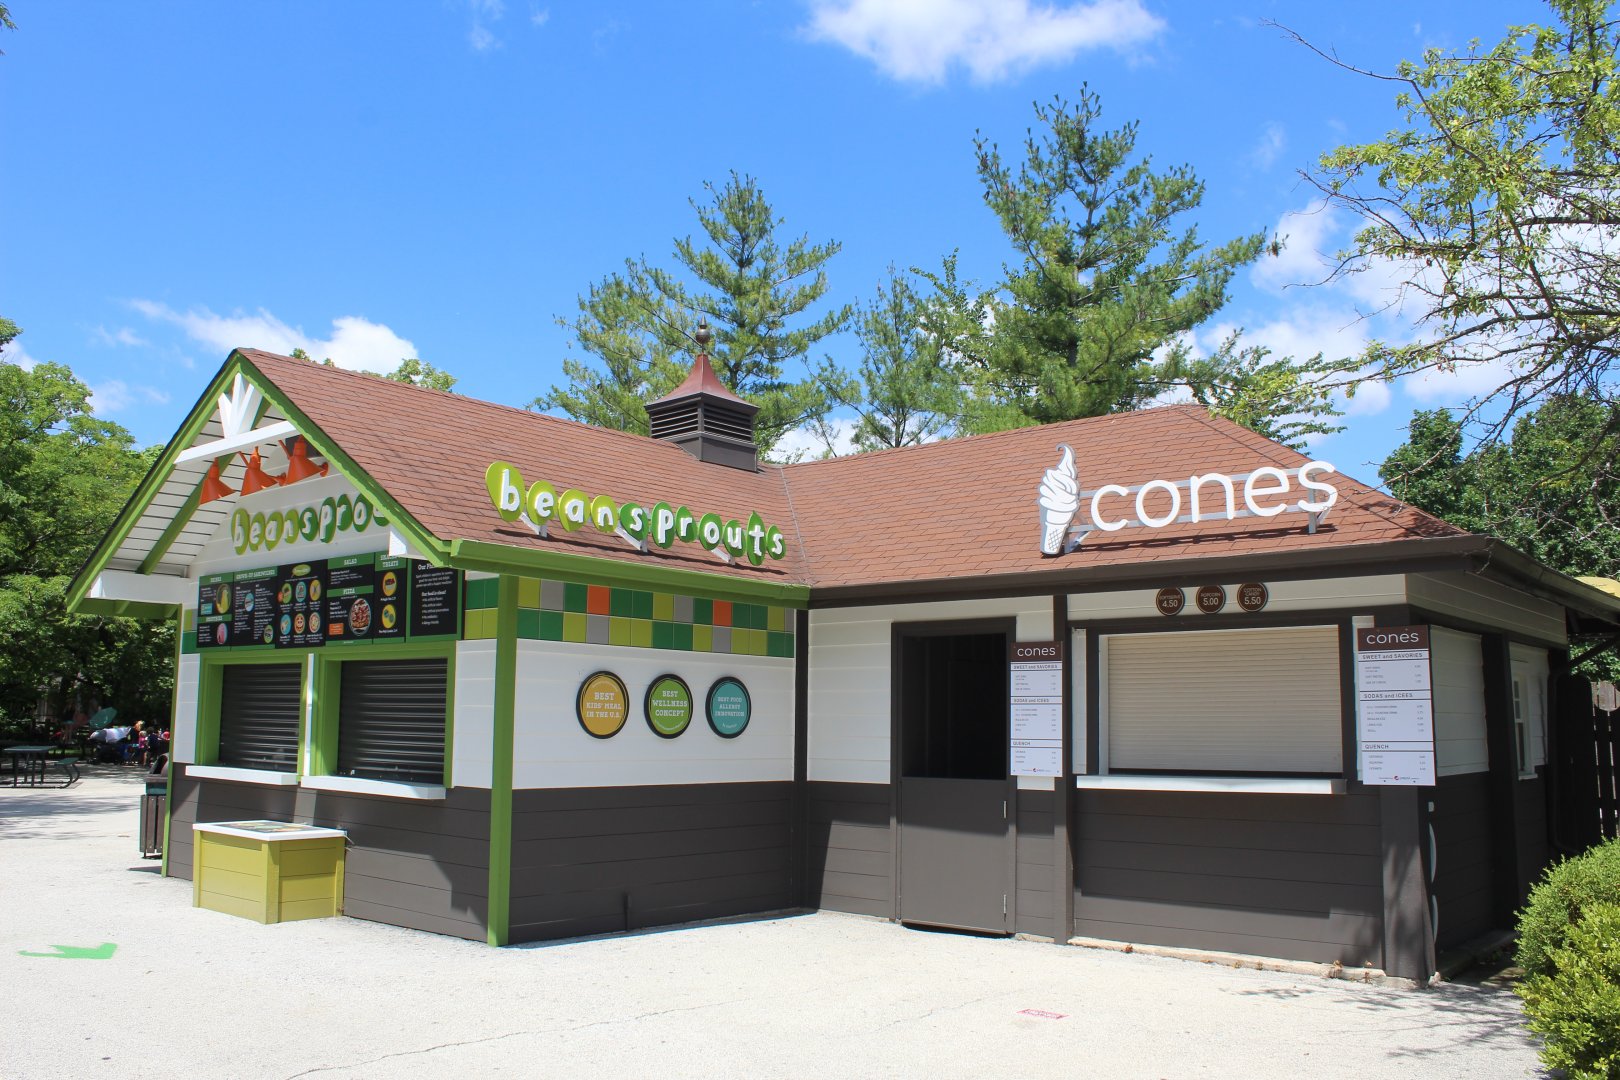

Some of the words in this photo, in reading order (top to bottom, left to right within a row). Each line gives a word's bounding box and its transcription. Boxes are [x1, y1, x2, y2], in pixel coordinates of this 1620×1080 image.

[1090, 460, 1339, 532] cones
[499, 468, 784, 557] beansprouts
[233, 500, 385, 549] beanspro
[1162, 600, 1178, 608] 4.50
[1202, 598, 1219, 606] 5.00
[1244, 596, 1261, 605] 5.50
[1366, 632, 1420, 645] cones
[1016, 647, 1056, 657] cones
[594, 692, 615, 701] BEST
